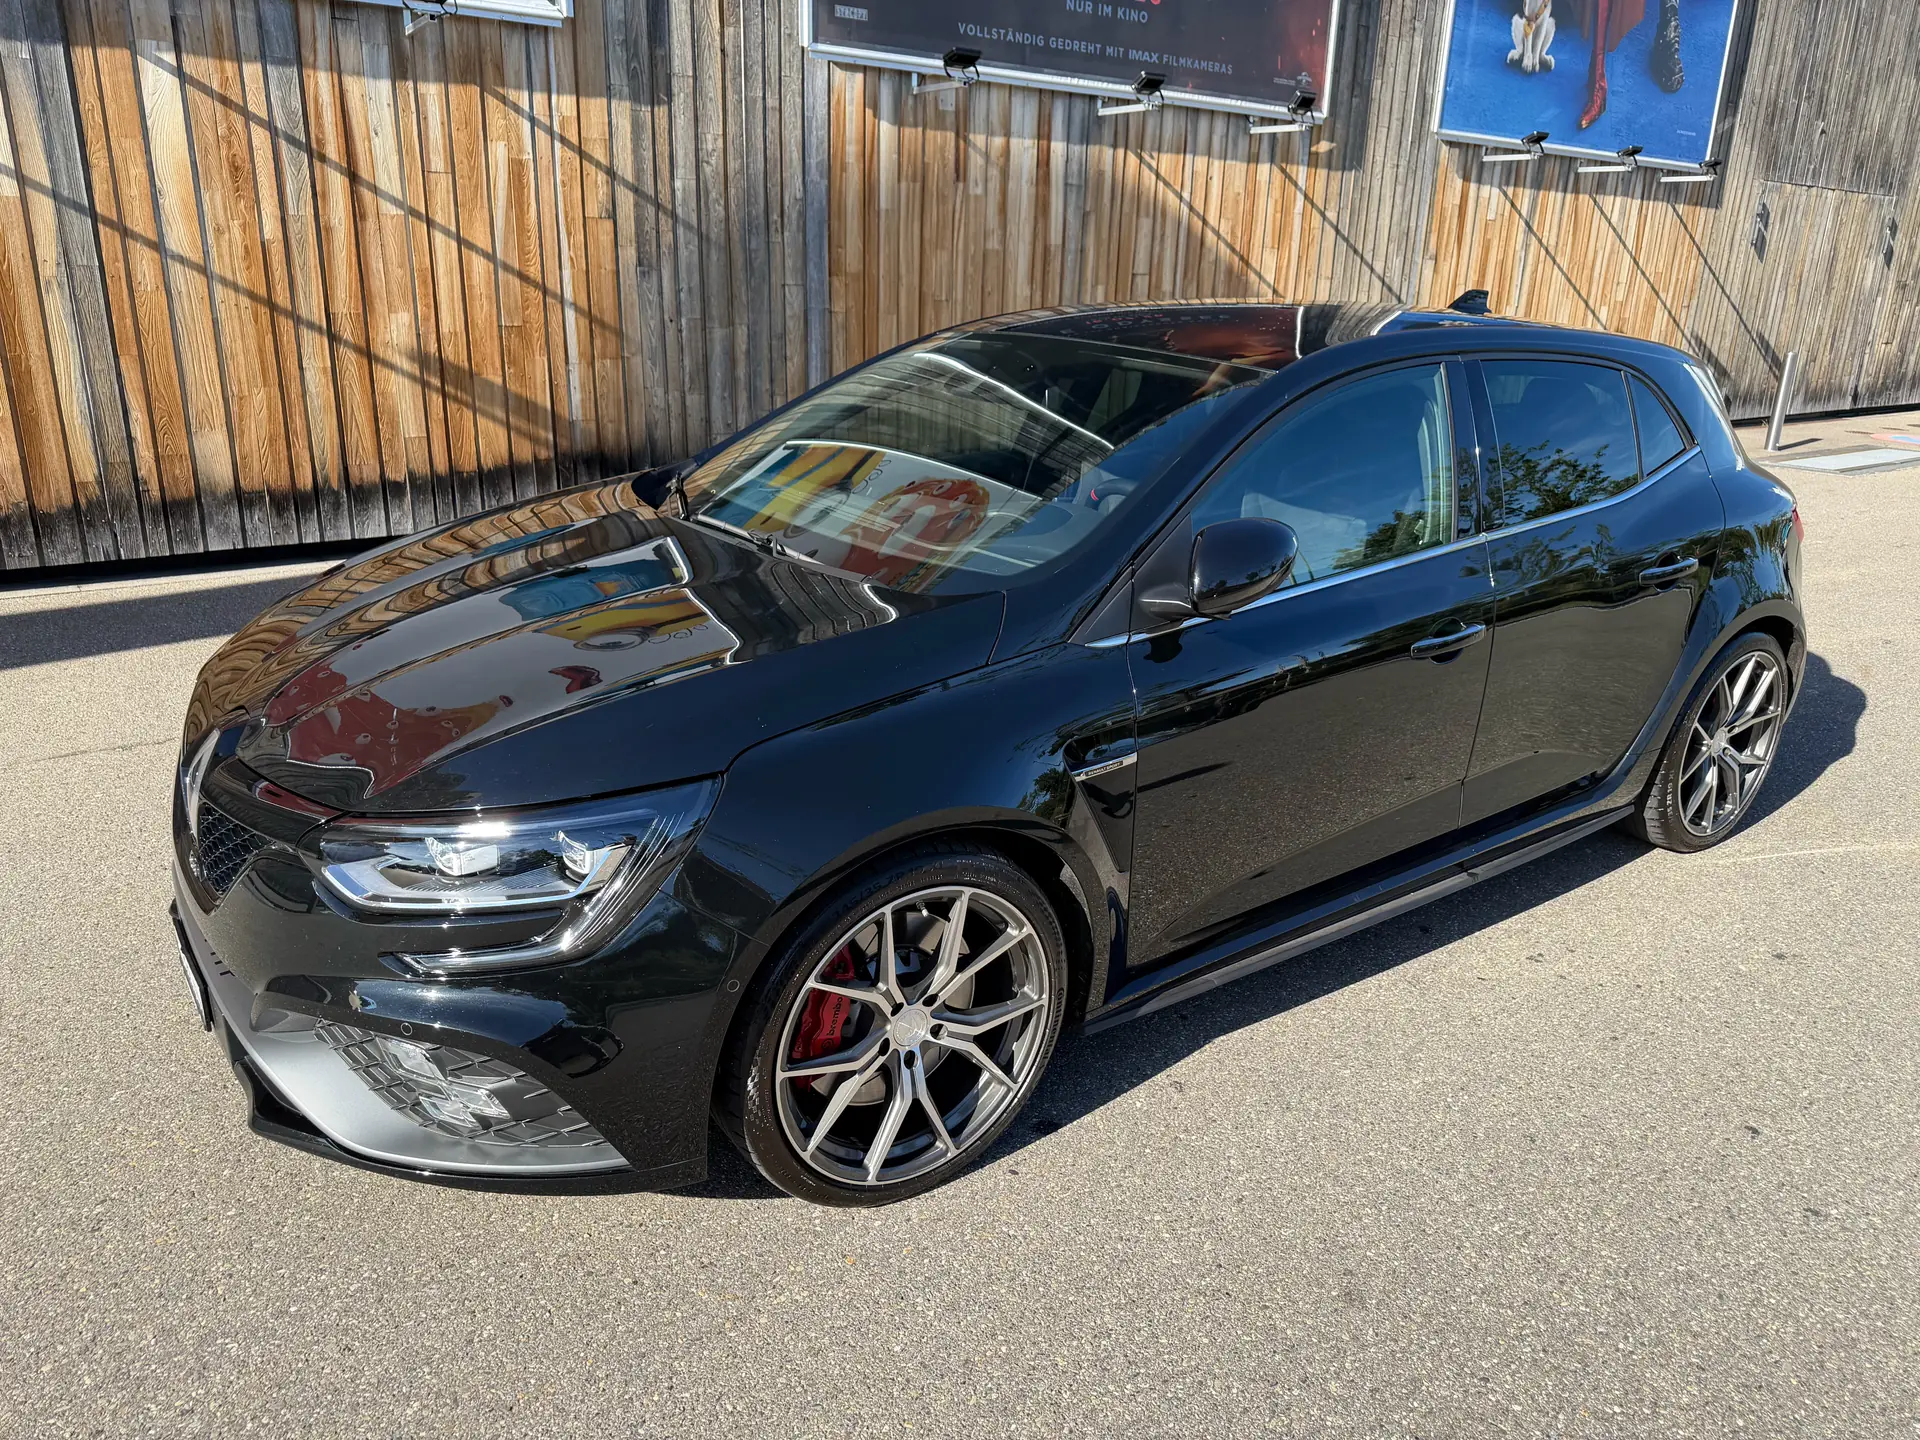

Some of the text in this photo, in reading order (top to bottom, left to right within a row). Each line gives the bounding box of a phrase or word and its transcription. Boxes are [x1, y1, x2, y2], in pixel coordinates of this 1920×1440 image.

[1066, 0, 1149, 24] NUR IM KINO
[957, 21, 1233, 76] VOLLSTÄNDIG GEDREHT MIT IMAX FILMKAMERAS
[826, 996, 844, 1036] brembo
[1042, 986, 1065, 1061] Continental
